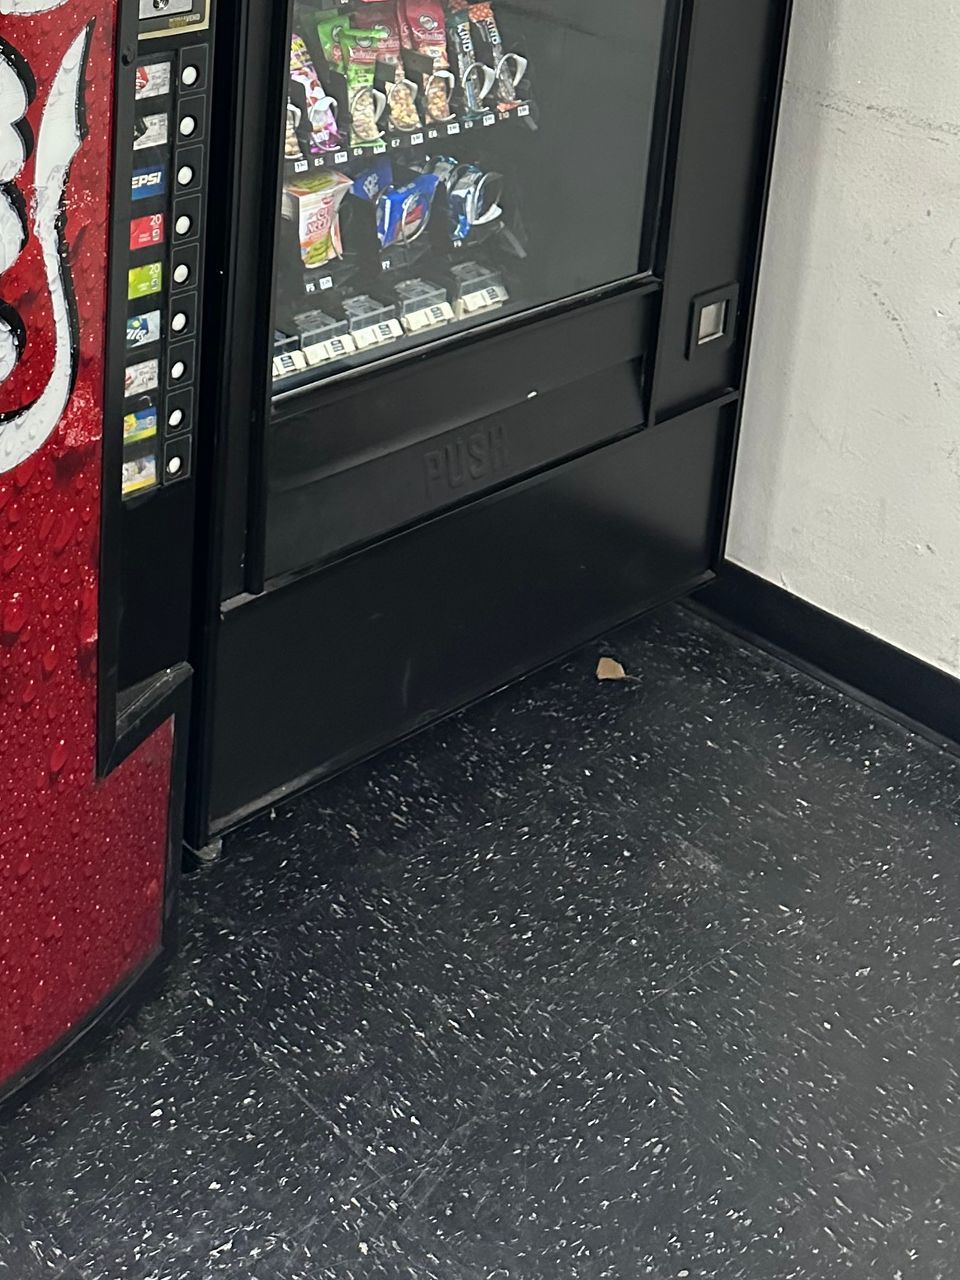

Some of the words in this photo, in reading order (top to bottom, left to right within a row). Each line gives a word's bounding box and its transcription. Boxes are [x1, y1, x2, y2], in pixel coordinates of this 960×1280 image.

[457, 23, 474, 52] KIND
[485, 17, 501, 45] KIND
[132, 172, 162, 189] EPSI
[423, 426, 504, 498] PUSH
